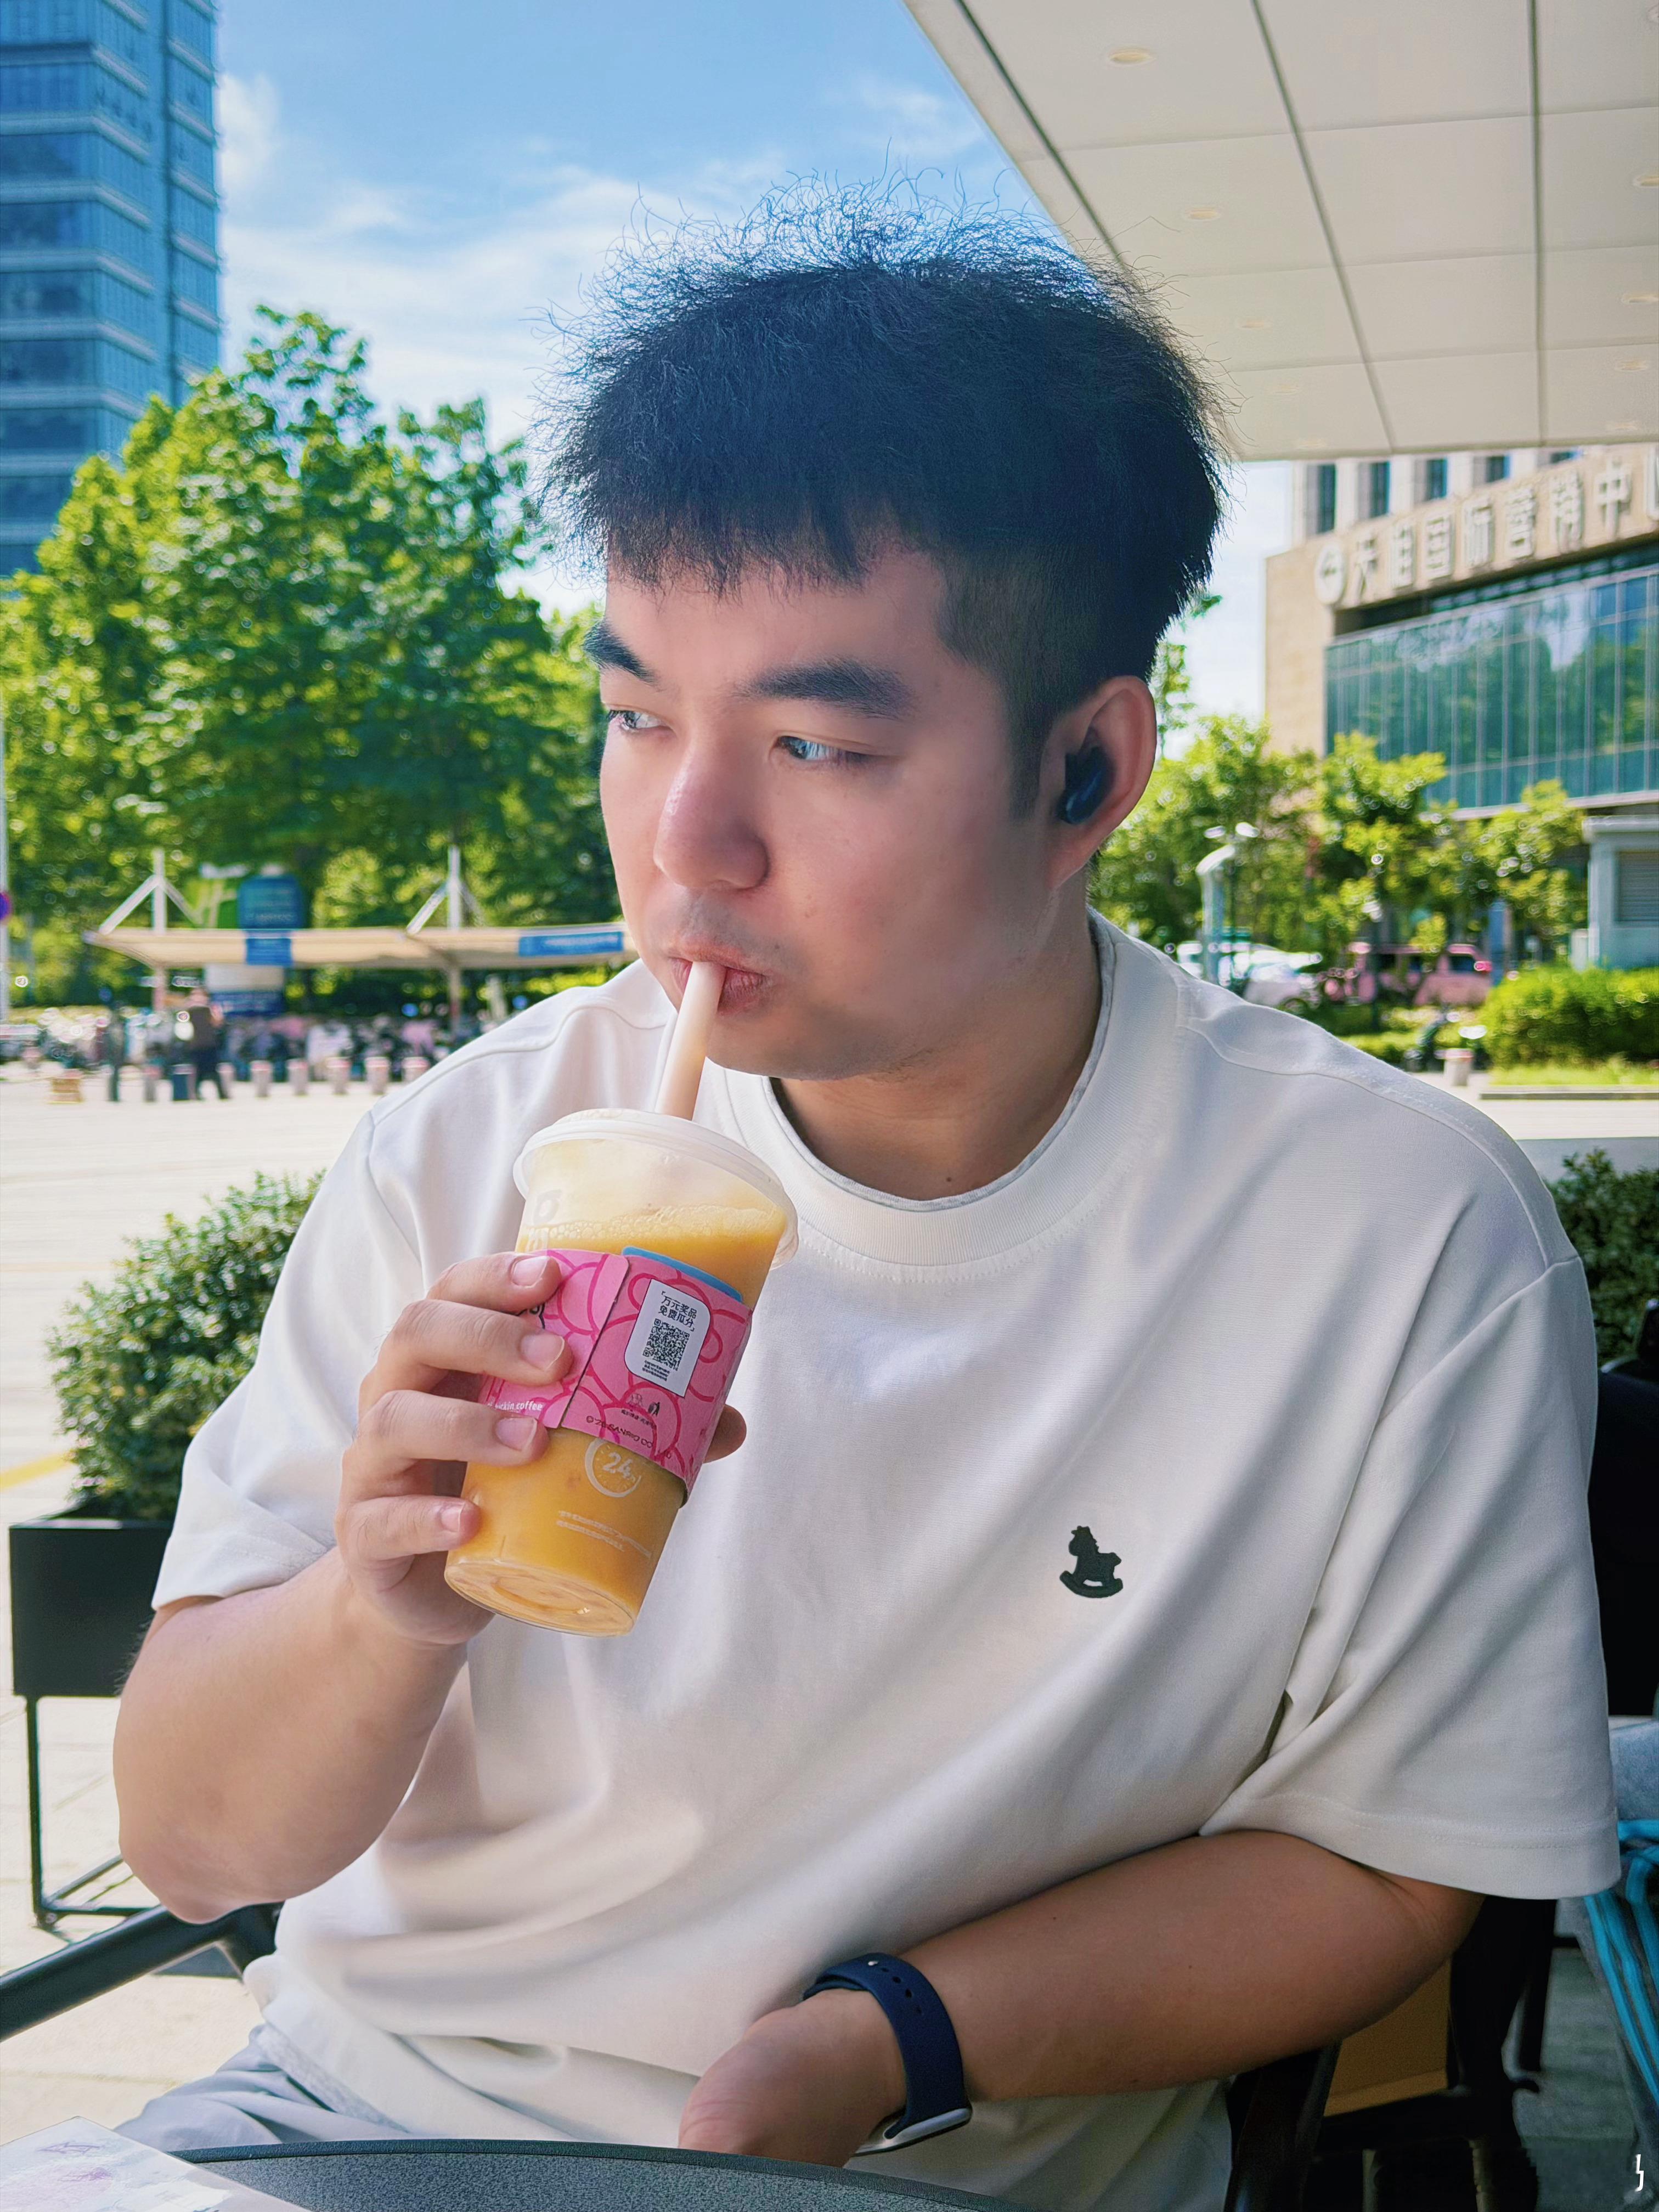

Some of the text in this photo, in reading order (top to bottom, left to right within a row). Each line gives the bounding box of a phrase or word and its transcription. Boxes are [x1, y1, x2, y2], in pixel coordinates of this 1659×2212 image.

[661, 1295, 697, 1319] 万元奖品
[516, 1401, 543, 1410] coffee
